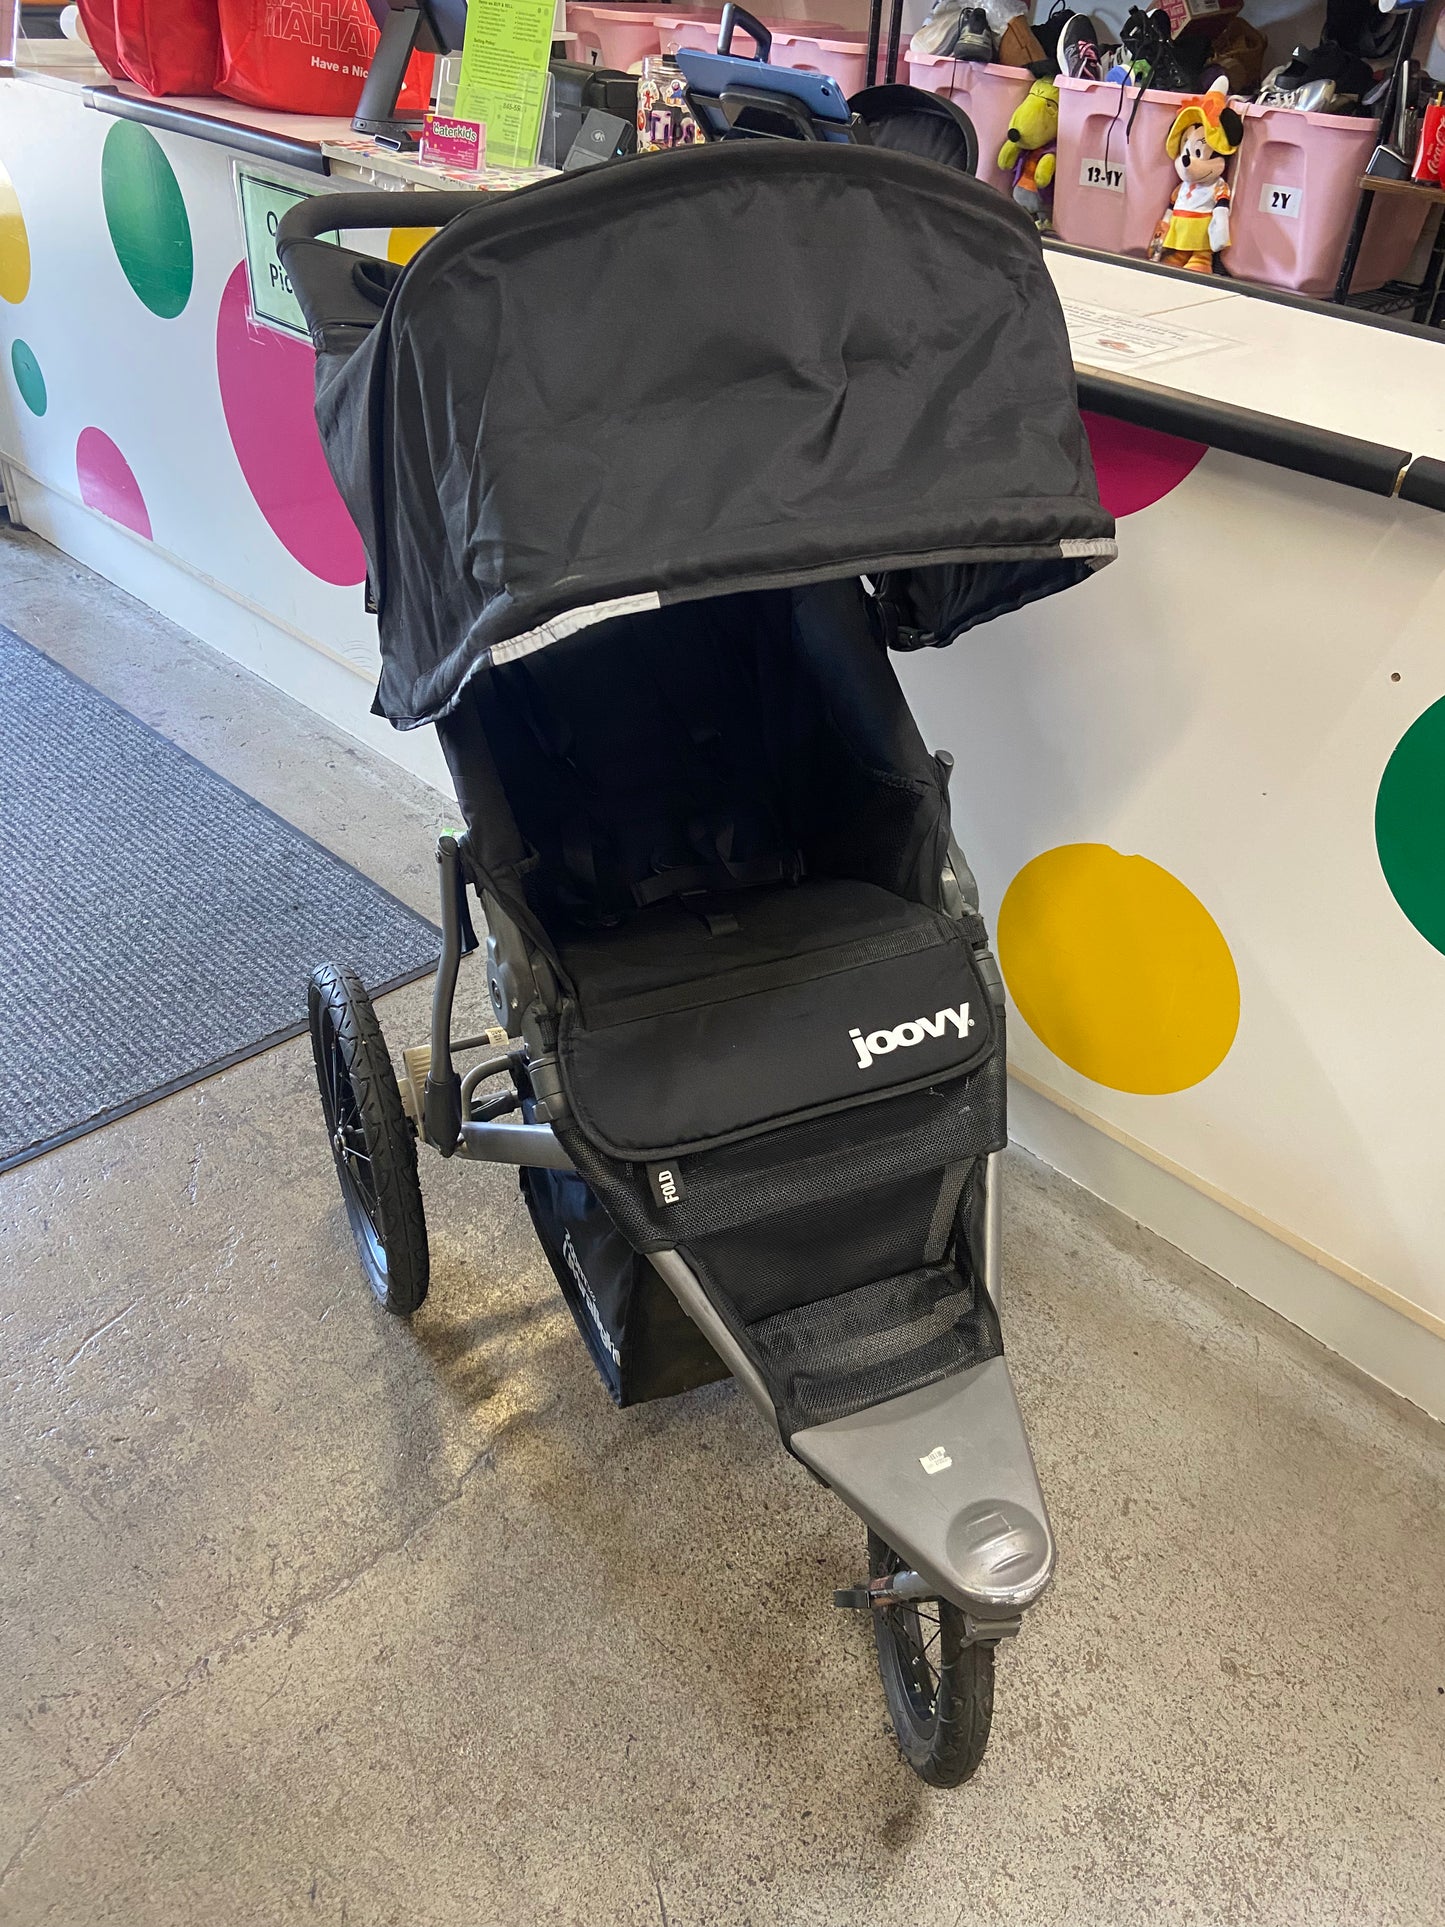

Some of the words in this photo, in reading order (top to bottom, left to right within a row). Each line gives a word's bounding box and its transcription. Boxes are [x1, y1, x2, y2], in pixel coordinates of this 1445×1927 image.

[311, 55, 339, 72] Have
[342, 64, 349, 74] a
[351, 65, 368, 79] Nic
[433, 121, 478, 143] Caterkids
[1087, 166, 1123, 188] 13-1Y
[1271, 191, 1293, 210] 2Y
[269, 262, 293, 294] Pic
[848, 1001, 970, 1070] joovy
[658, 1170, 680, 1204] FOLD
